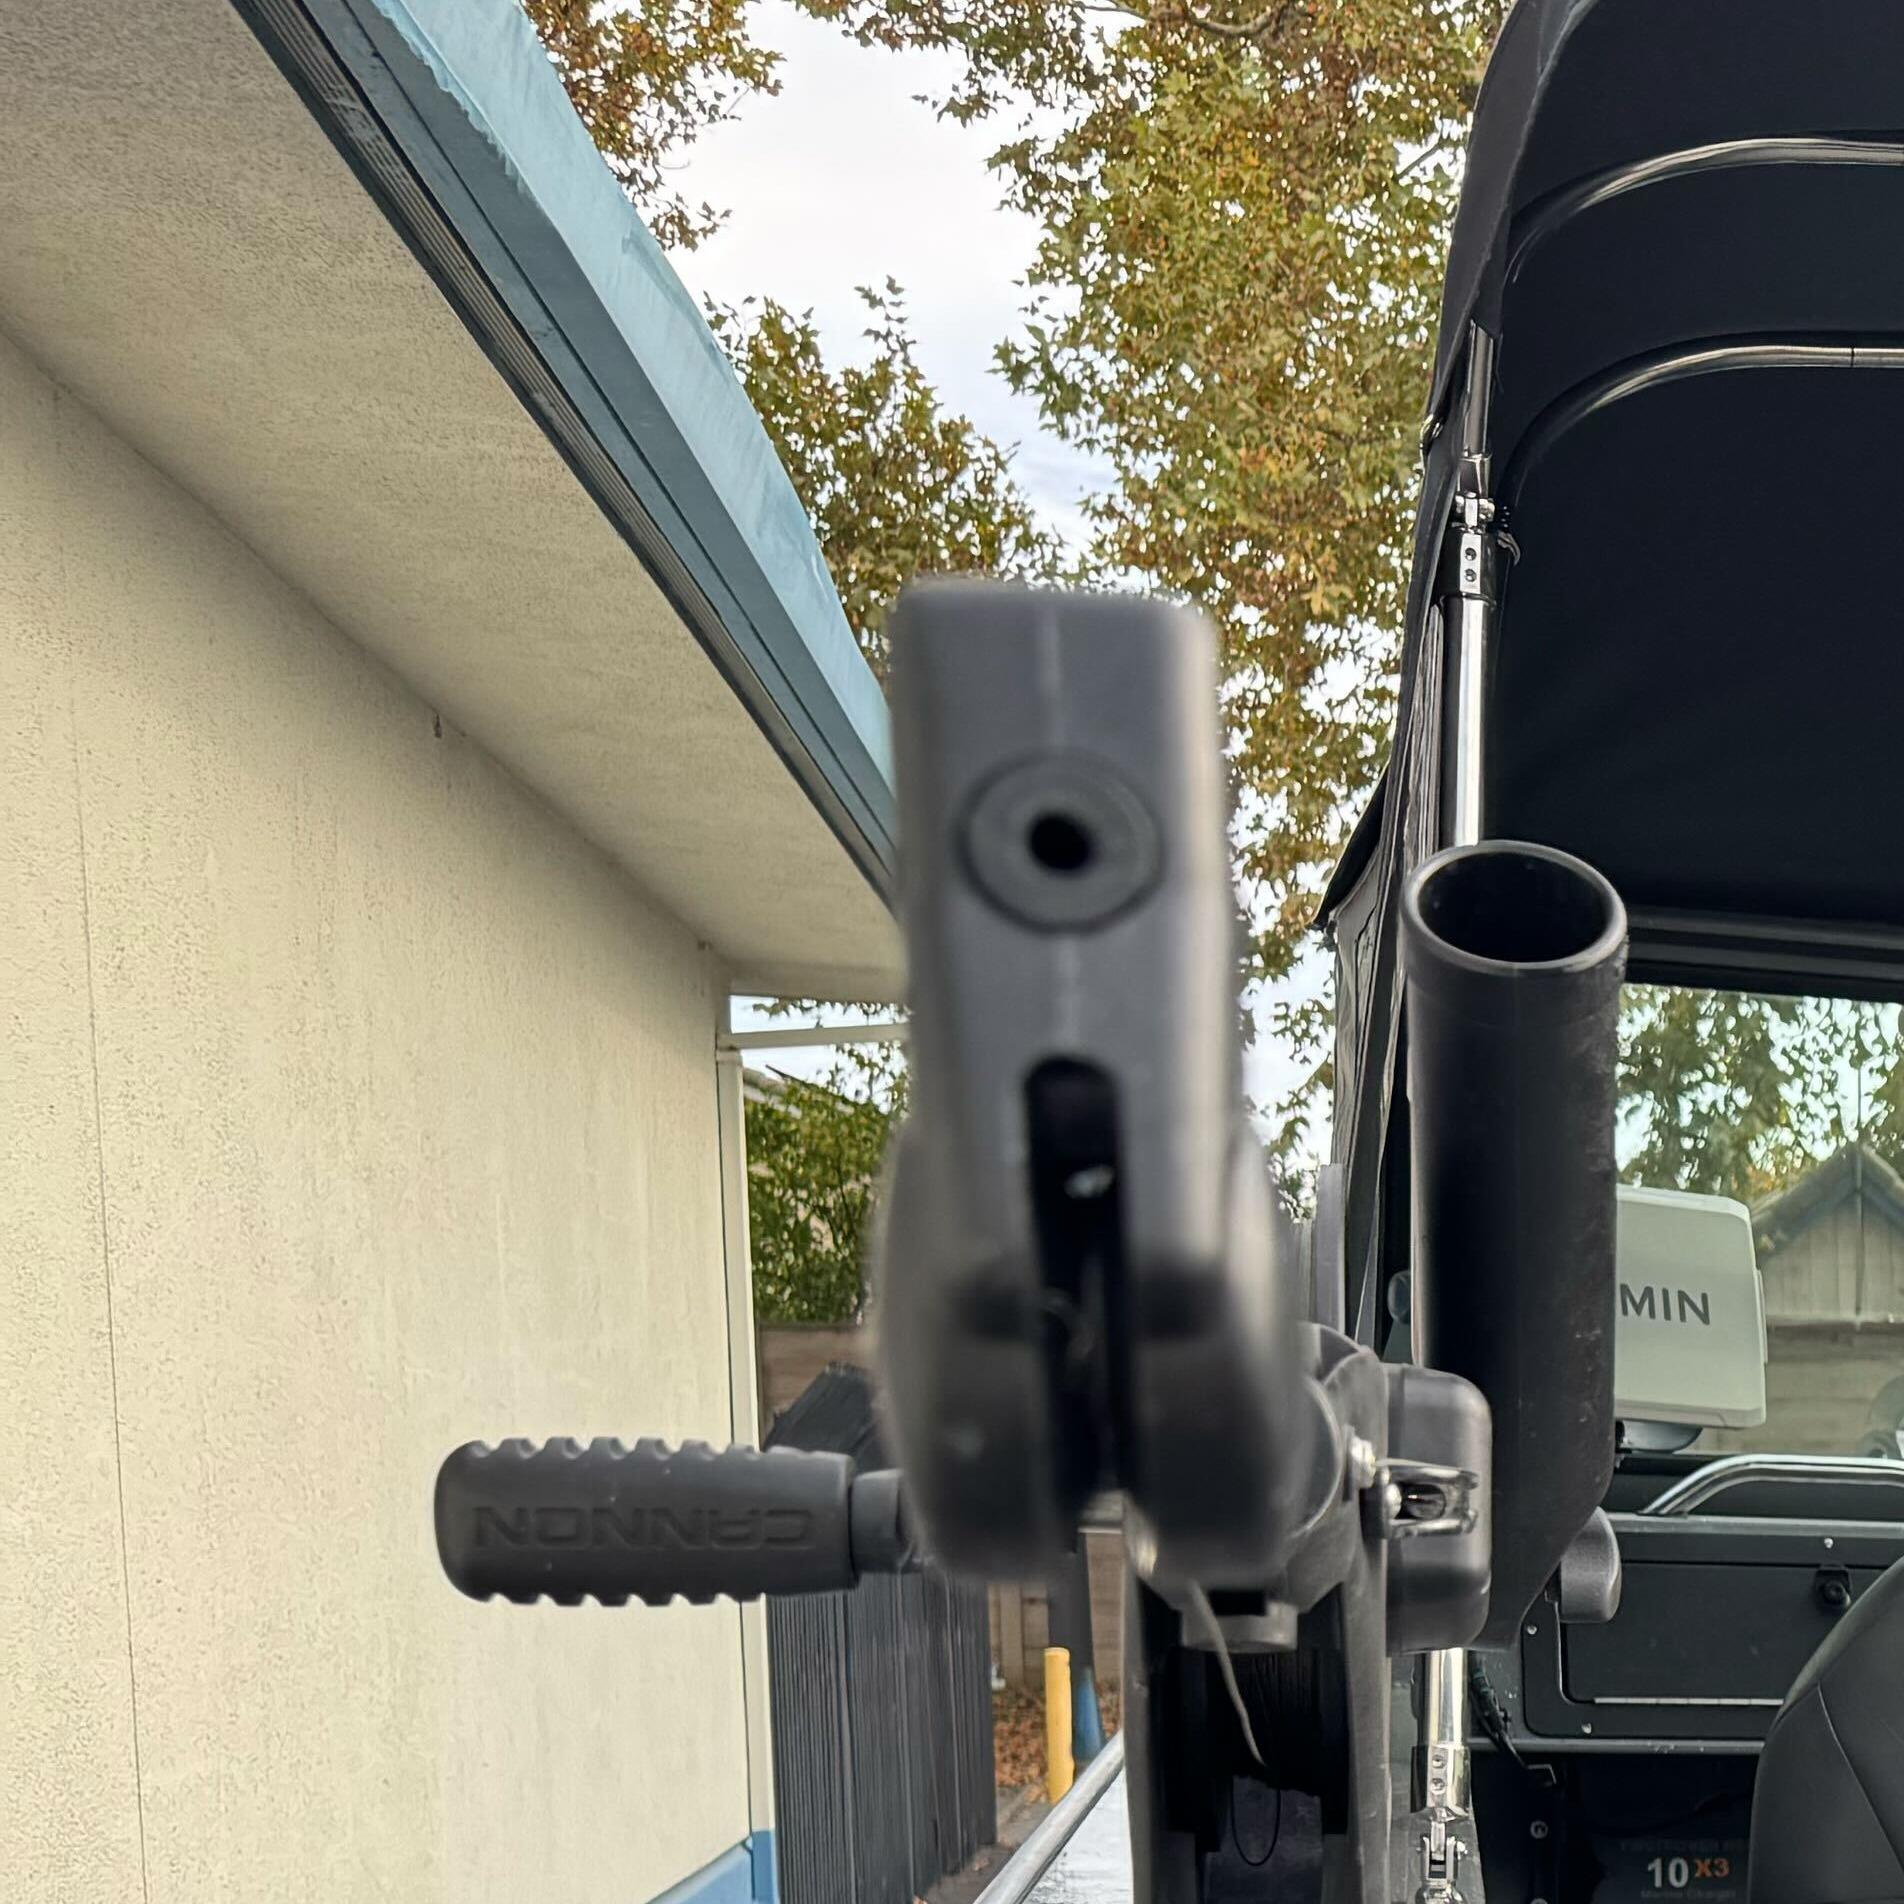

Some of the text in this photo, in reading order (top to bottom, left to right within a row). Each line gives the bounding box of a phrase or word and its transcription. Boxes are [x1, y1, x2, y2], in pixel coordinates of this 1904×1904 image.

[1619, 1283, 1710, 1326] MIN
[474, 1506, 813, 1549] CANNON
[1647, 1857, 1689, 1889] 10
